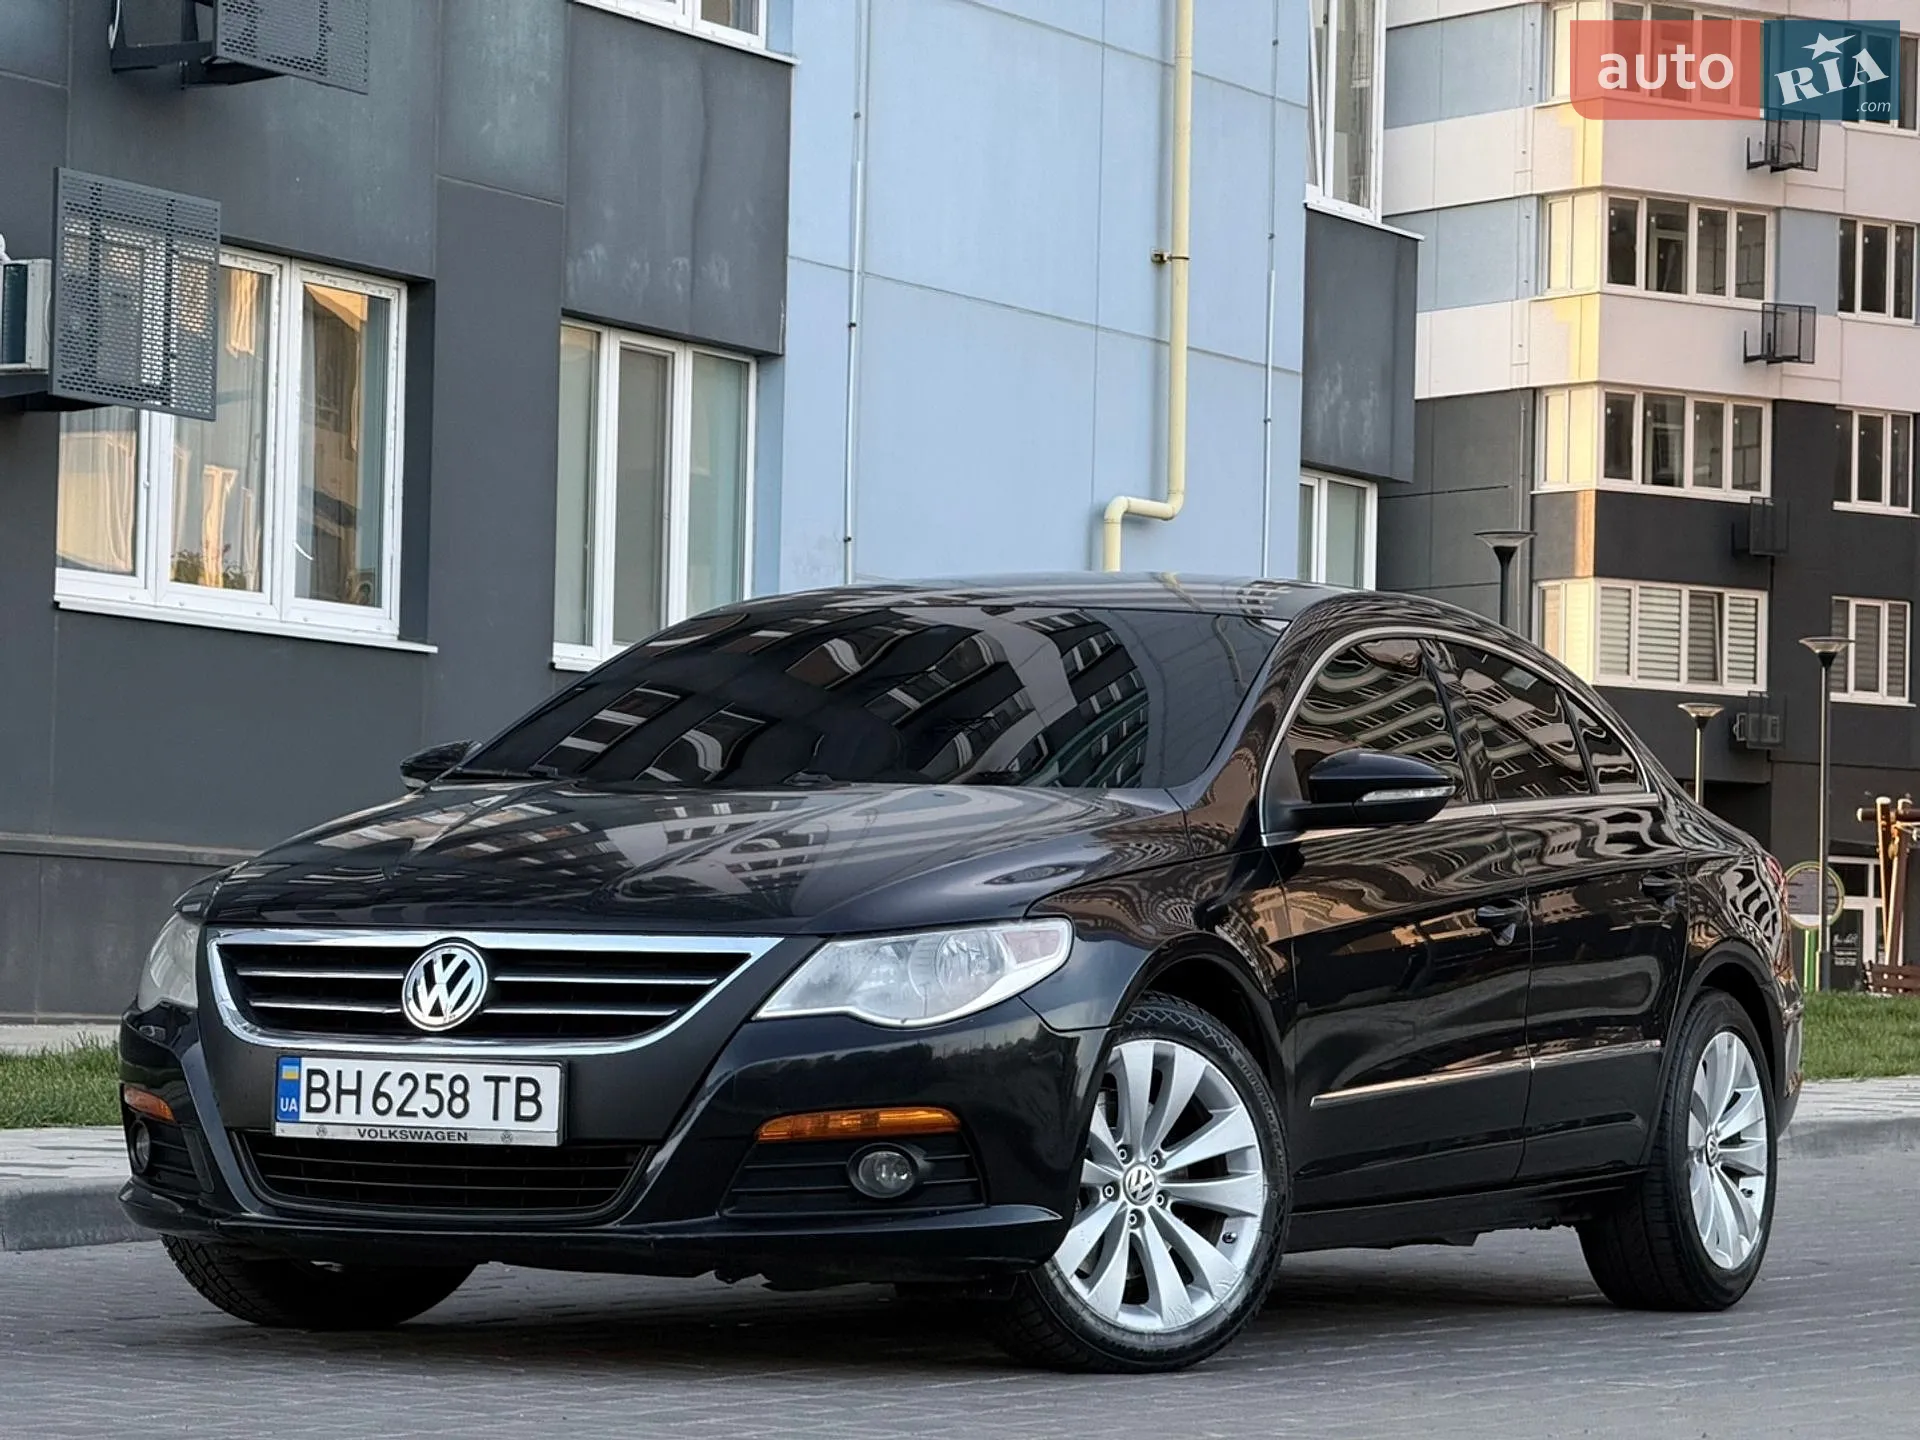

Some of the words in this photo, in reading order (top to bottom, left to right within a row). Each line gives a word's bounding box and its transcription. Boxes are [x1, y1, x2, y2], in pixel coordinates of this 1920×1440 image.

[305, 1068, 363, 1115] BH
[372, 1071, 470, 1119] 6258
[483, 1075, 543, 1122] TB
[280, 1097, 298, 1113] UA
[357, 1128, 469, 1142] VOLKSWAGEN
